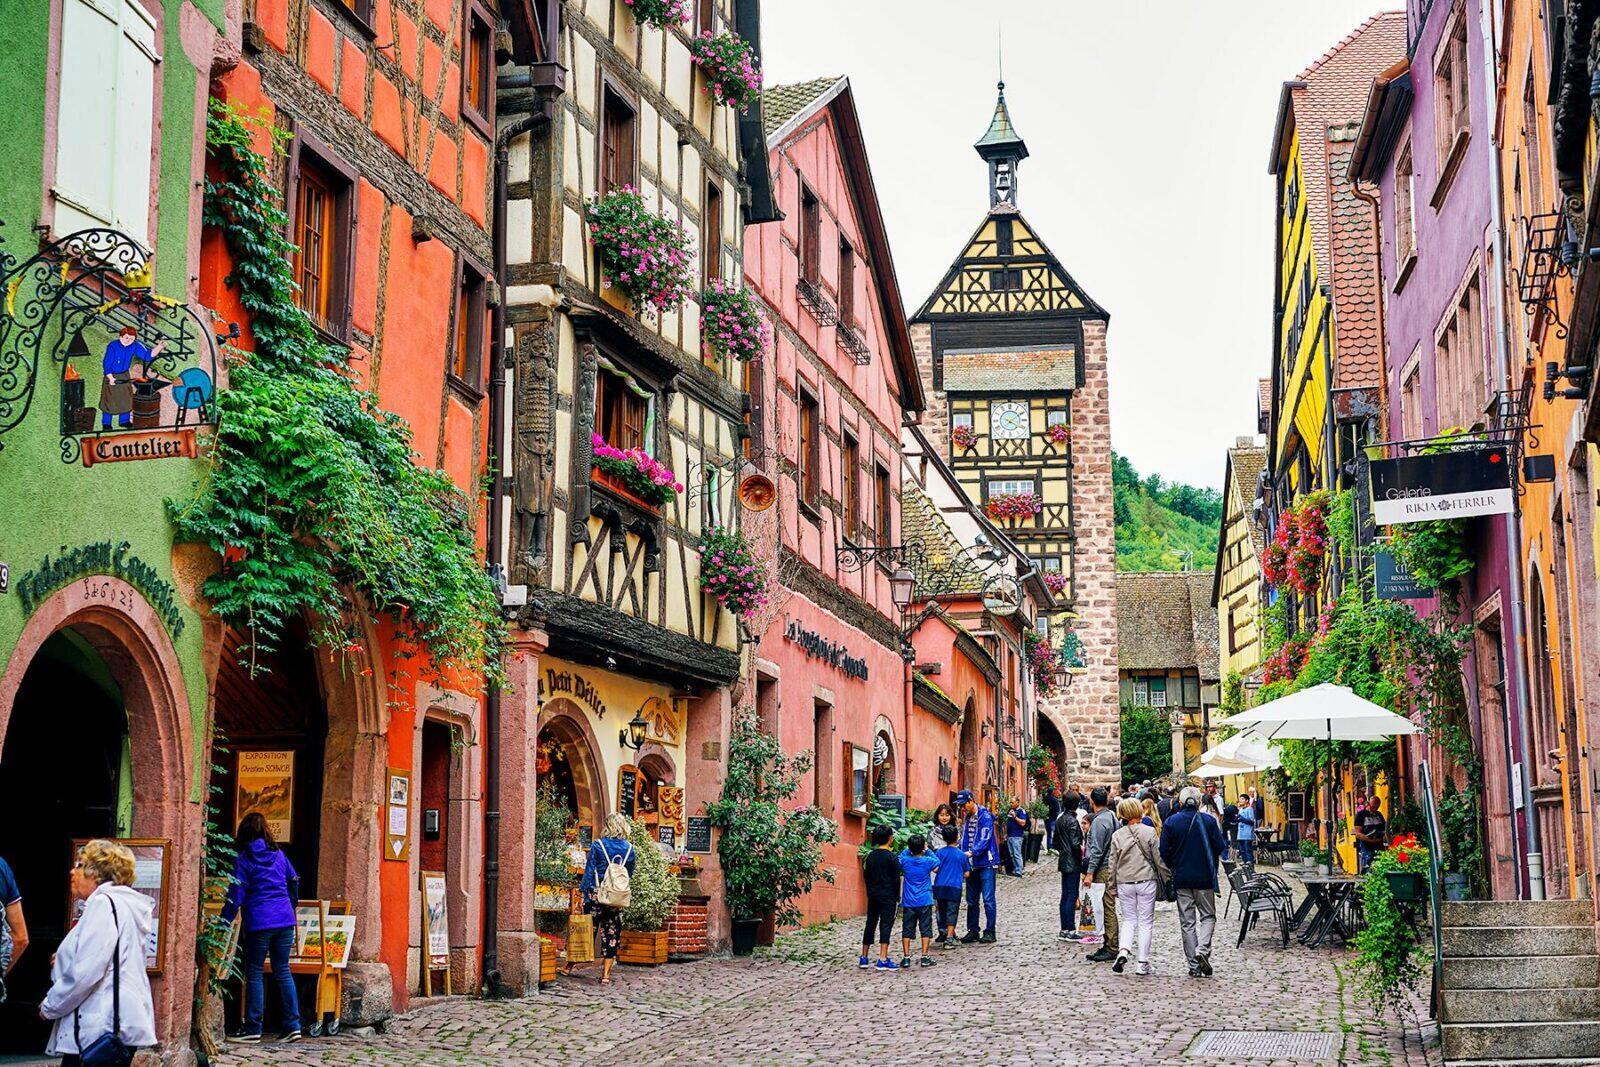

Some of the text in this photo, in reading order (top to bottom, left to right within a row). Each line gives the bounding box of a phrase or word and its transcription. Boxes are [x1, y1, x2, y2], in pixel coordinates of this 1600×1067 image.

[96, 437, 181, 459] Coutelier
[1386, 487, 1432, 500] Galerie
[1406, 496, 1496, 514] RIKIA FERRER
[546, 668, 572, 697] Petit
[574, 673, 606, 720] Délice
[245, 752, 288, 760] EXPOSITION
[240, 765, 264, 773] Christian
